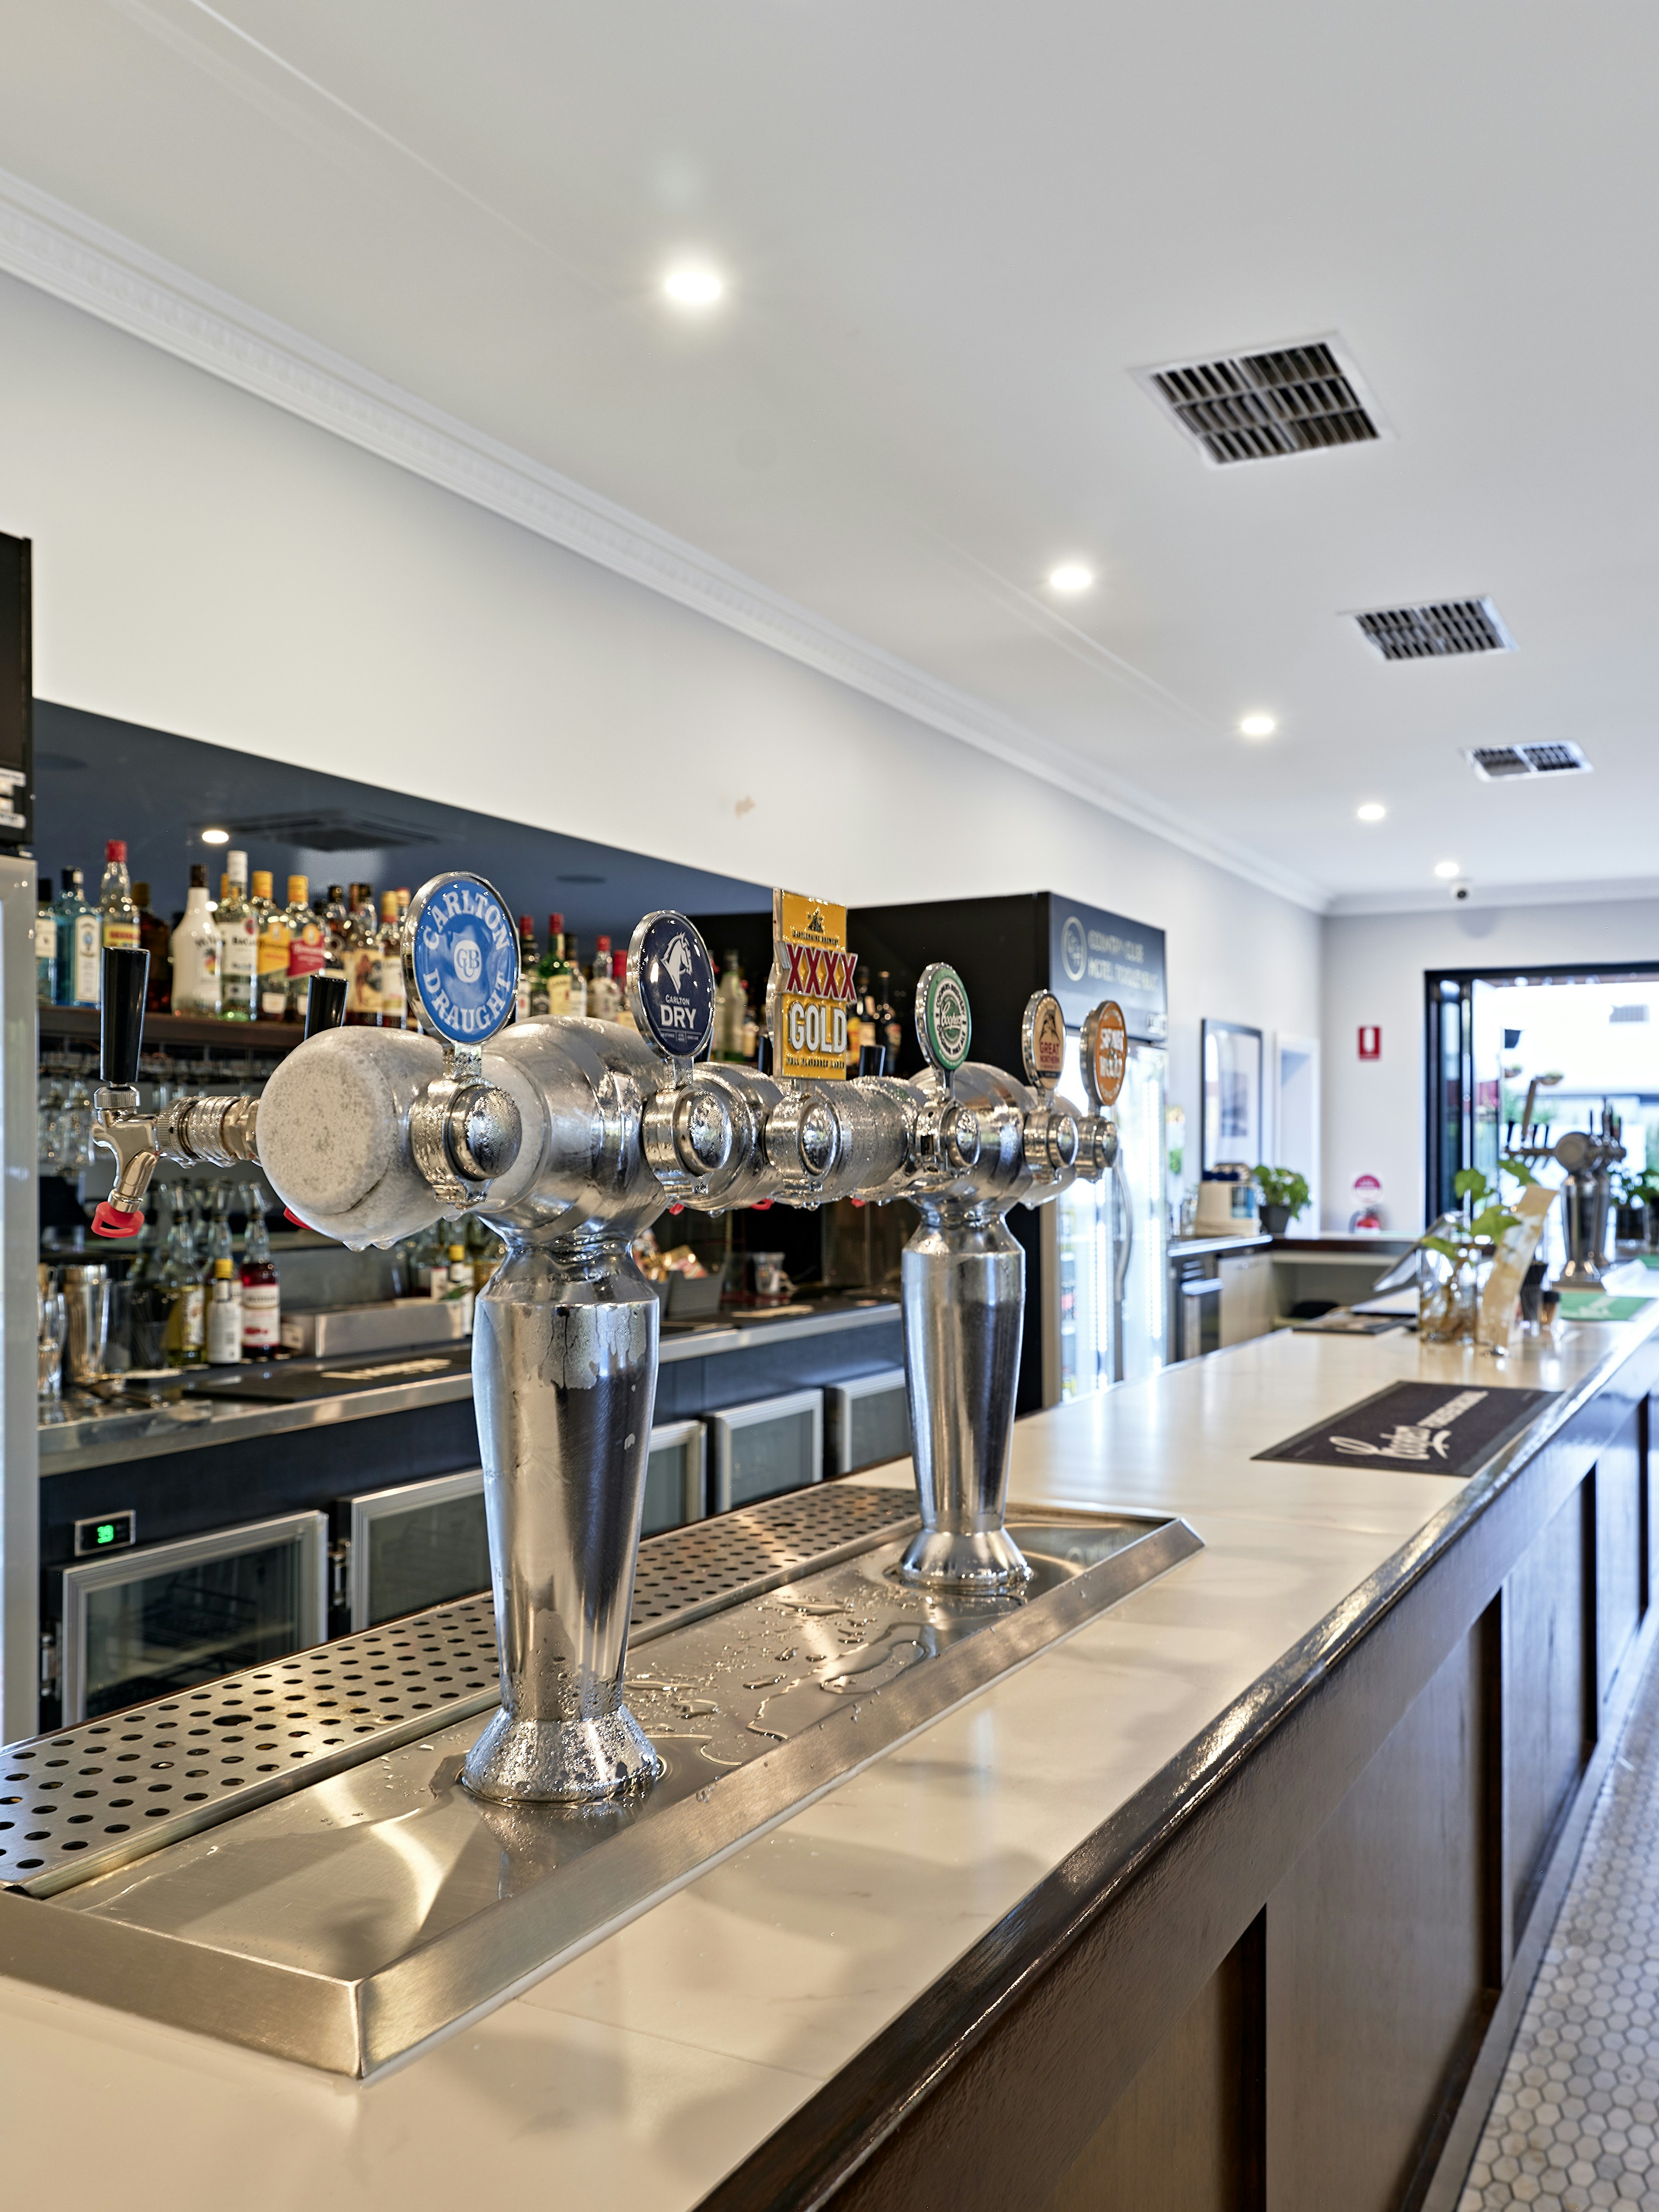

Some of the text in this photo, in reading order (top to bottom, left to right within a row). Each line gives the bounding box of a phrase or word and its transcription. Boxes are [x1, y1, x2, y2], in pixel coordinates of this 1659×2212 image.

[423, 890, 510, 950] CARLTON
[793, 931, 839, 946] CASTLEMAINE BREWERY
[785, 943, 858, 1003] XXXX
[423, 968, 511, 1033] DRAUGHT
[665, 994, 690, 1006] CARLTON
[936, 983, 966, 1015] COOPERS BREWERY
[660, 1004, 697, 1030] DRY
[790, 1002, 847, 1054] GOLD
[953, 1044, 961, 1055] PALE
[1040, 1041, 1060, 1055] GREAT
[787, 1057, 845, 1069] FULL FLAVOURED LAGER
[1040, 1056, 1060, 1064] NORTHERN
